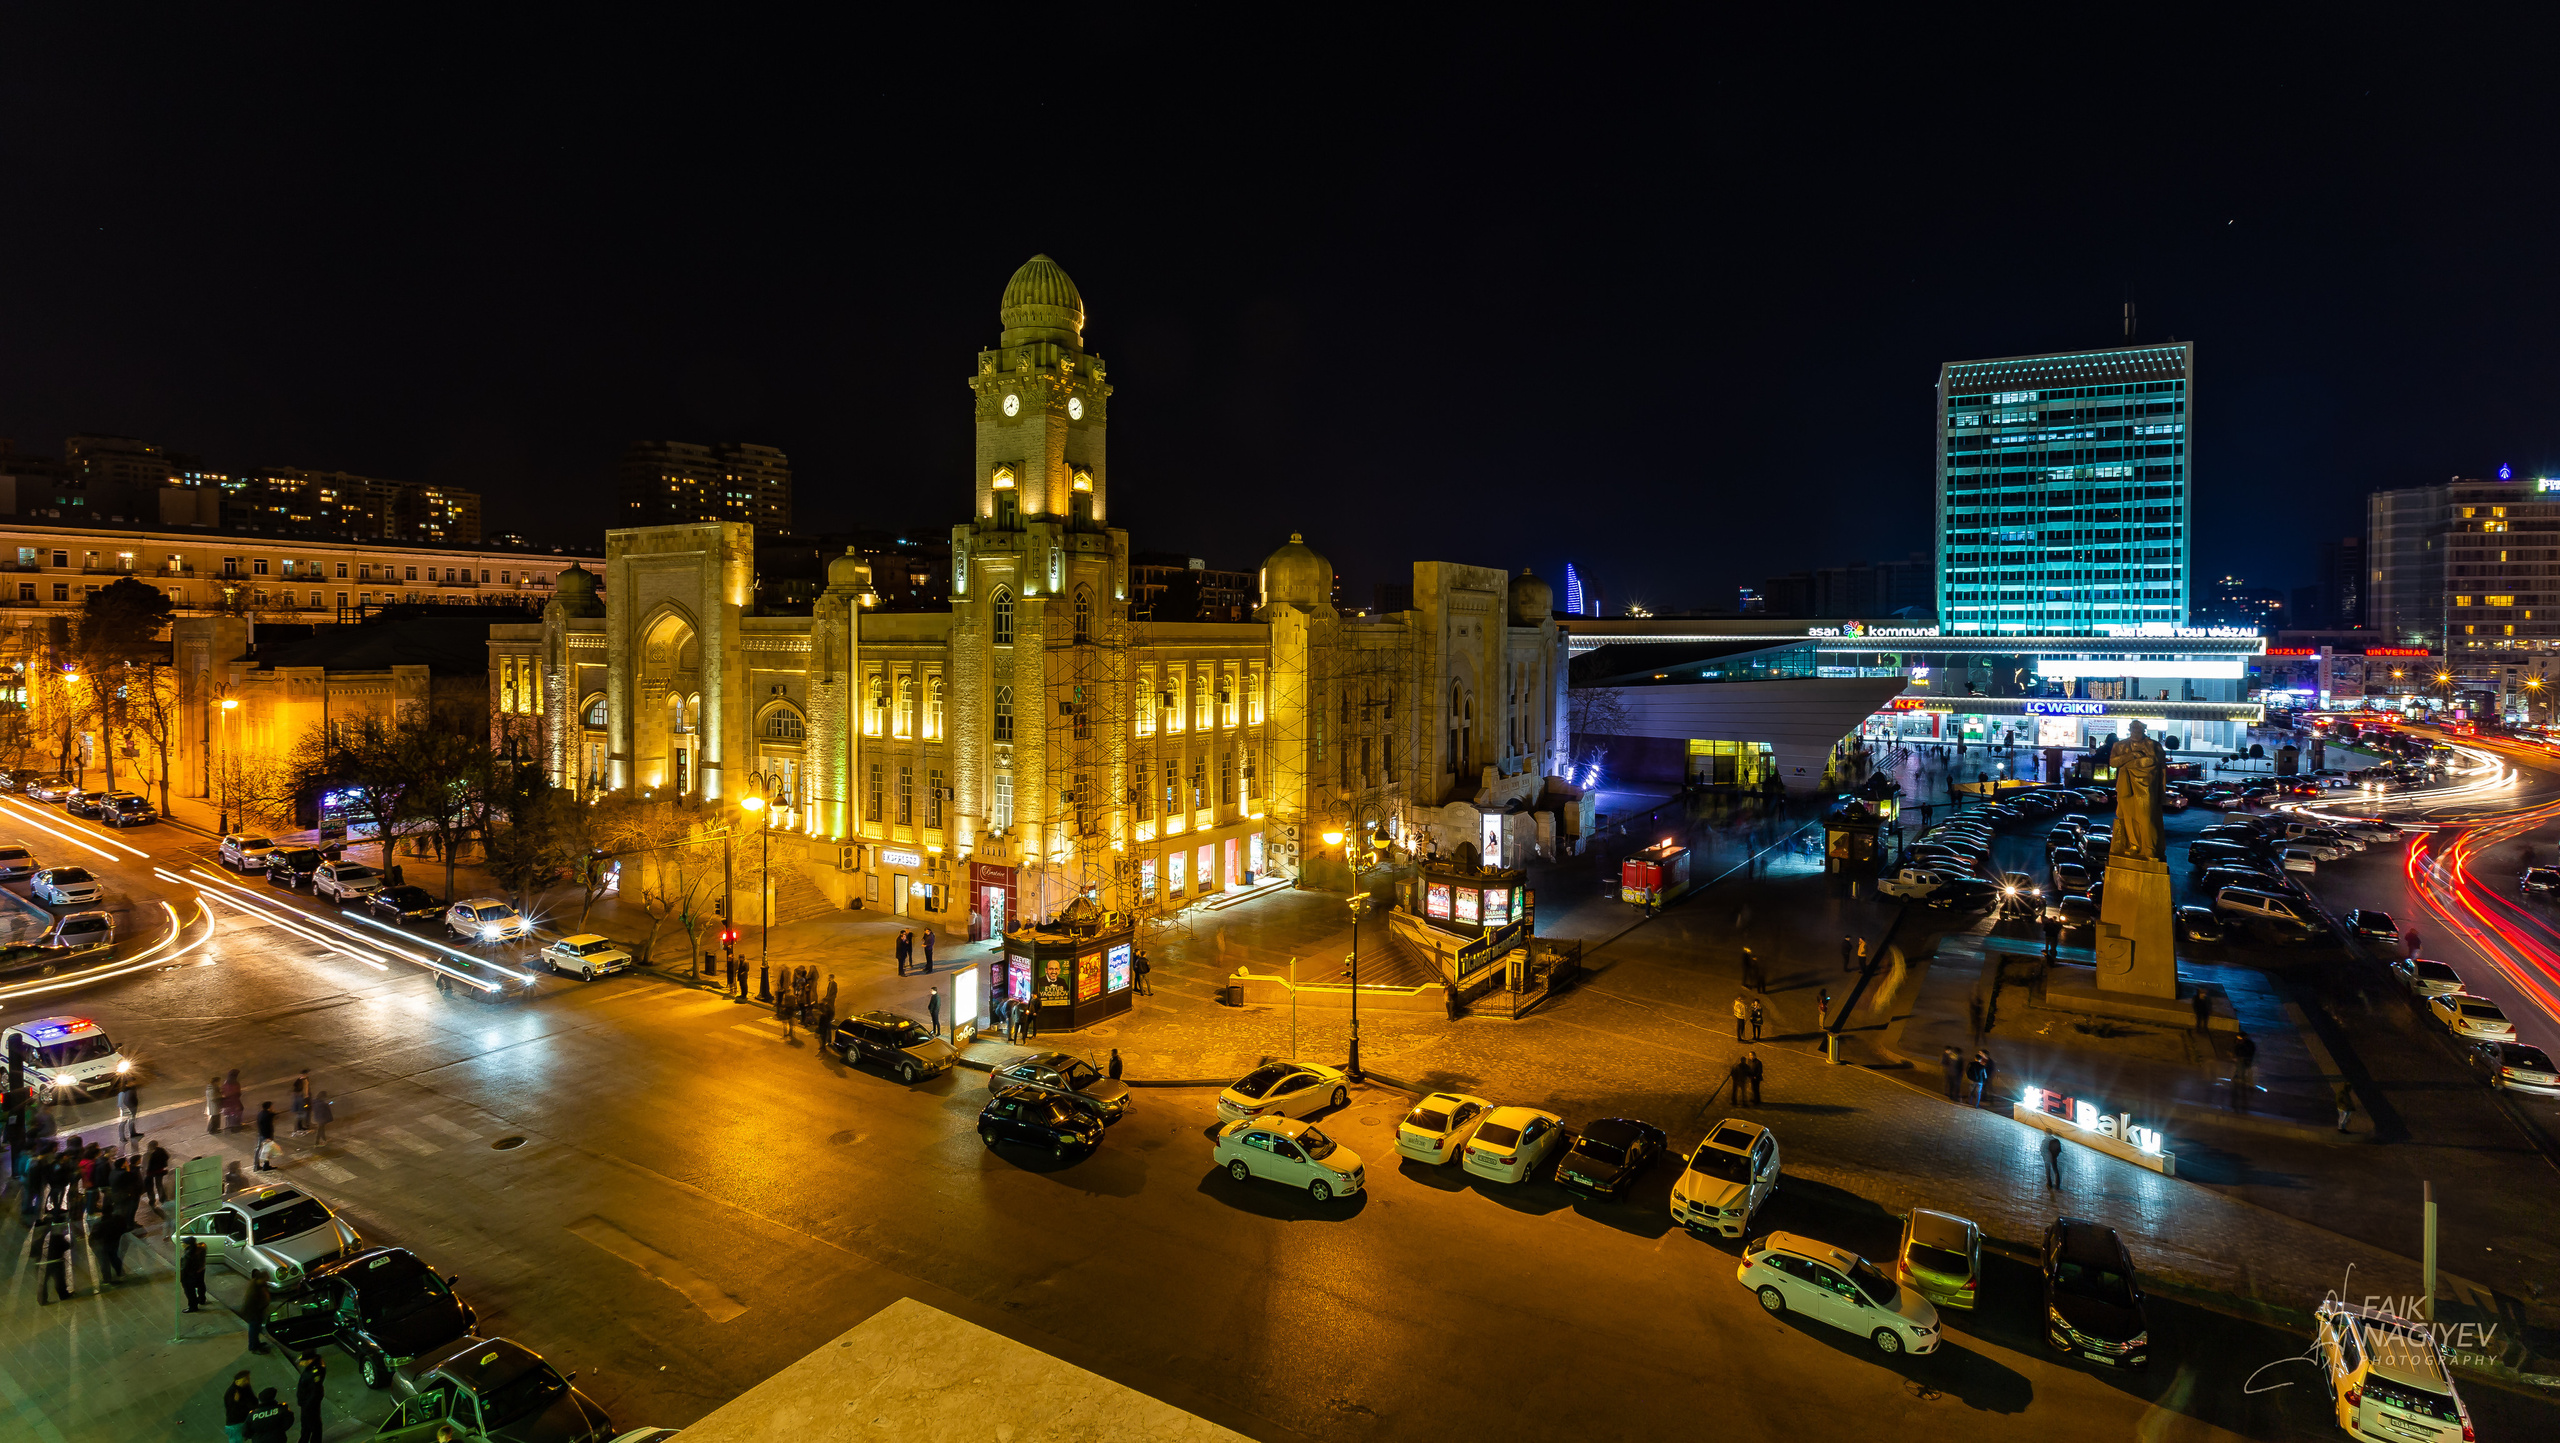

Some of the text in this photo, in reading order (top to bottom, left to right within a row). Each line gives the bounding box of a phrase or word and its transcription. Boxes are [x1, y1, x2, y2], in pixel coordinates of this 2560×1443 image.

[1808, 624, 1940, 637] asan kommunal
[1894, 699, 1925, 710] KFC
[2026, 702, 2046, 713] LC
